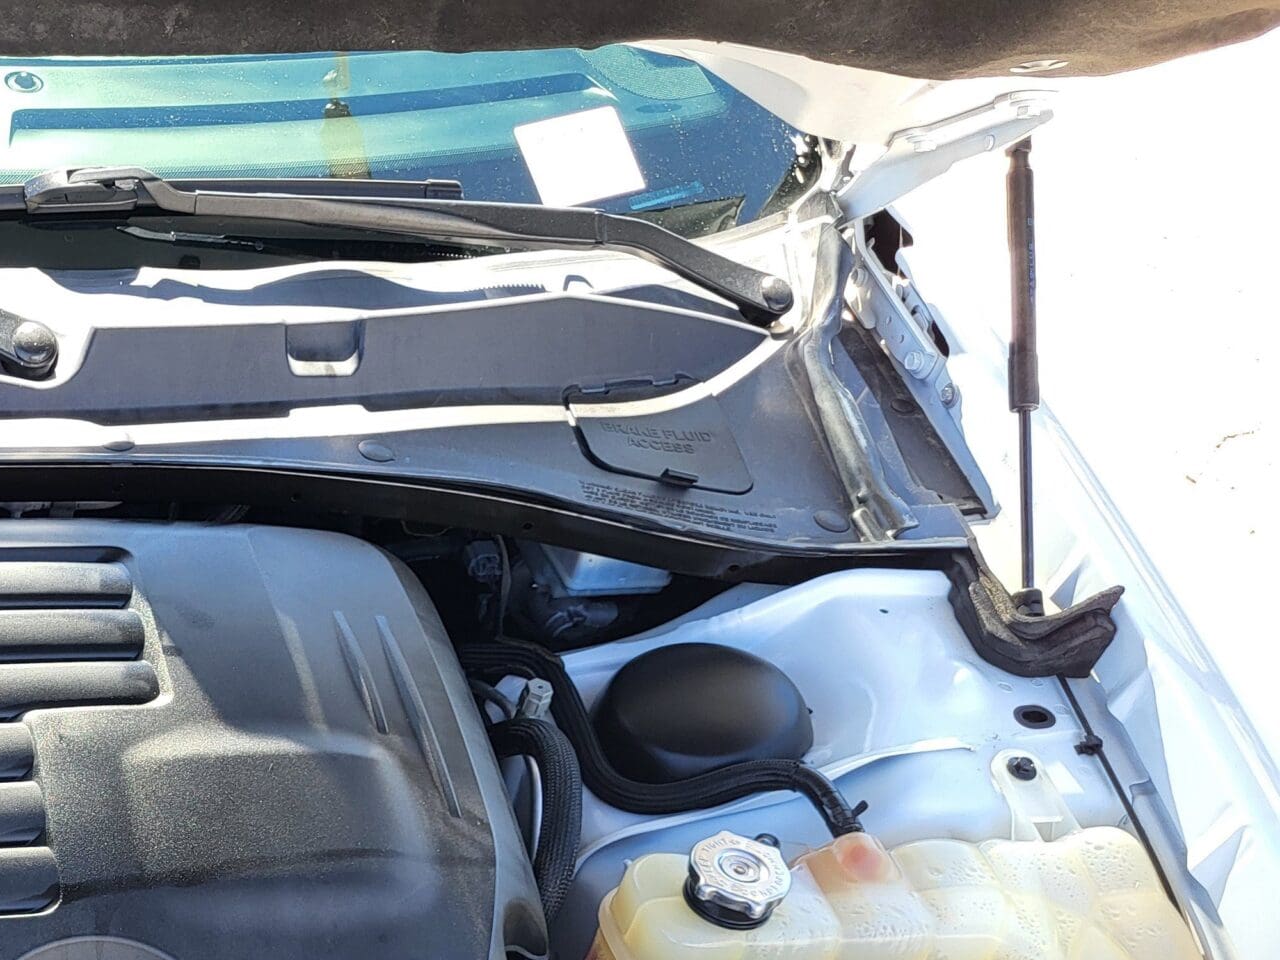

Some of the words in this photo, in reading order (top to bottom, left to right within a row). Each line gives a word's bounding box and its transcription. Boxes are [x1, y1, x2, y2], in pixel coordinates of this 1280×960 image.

[600, 421, 659, 439] BRAKE
[663, 428, 712, 443] FLUID
[627, 438, 696, 454] ACCESS
